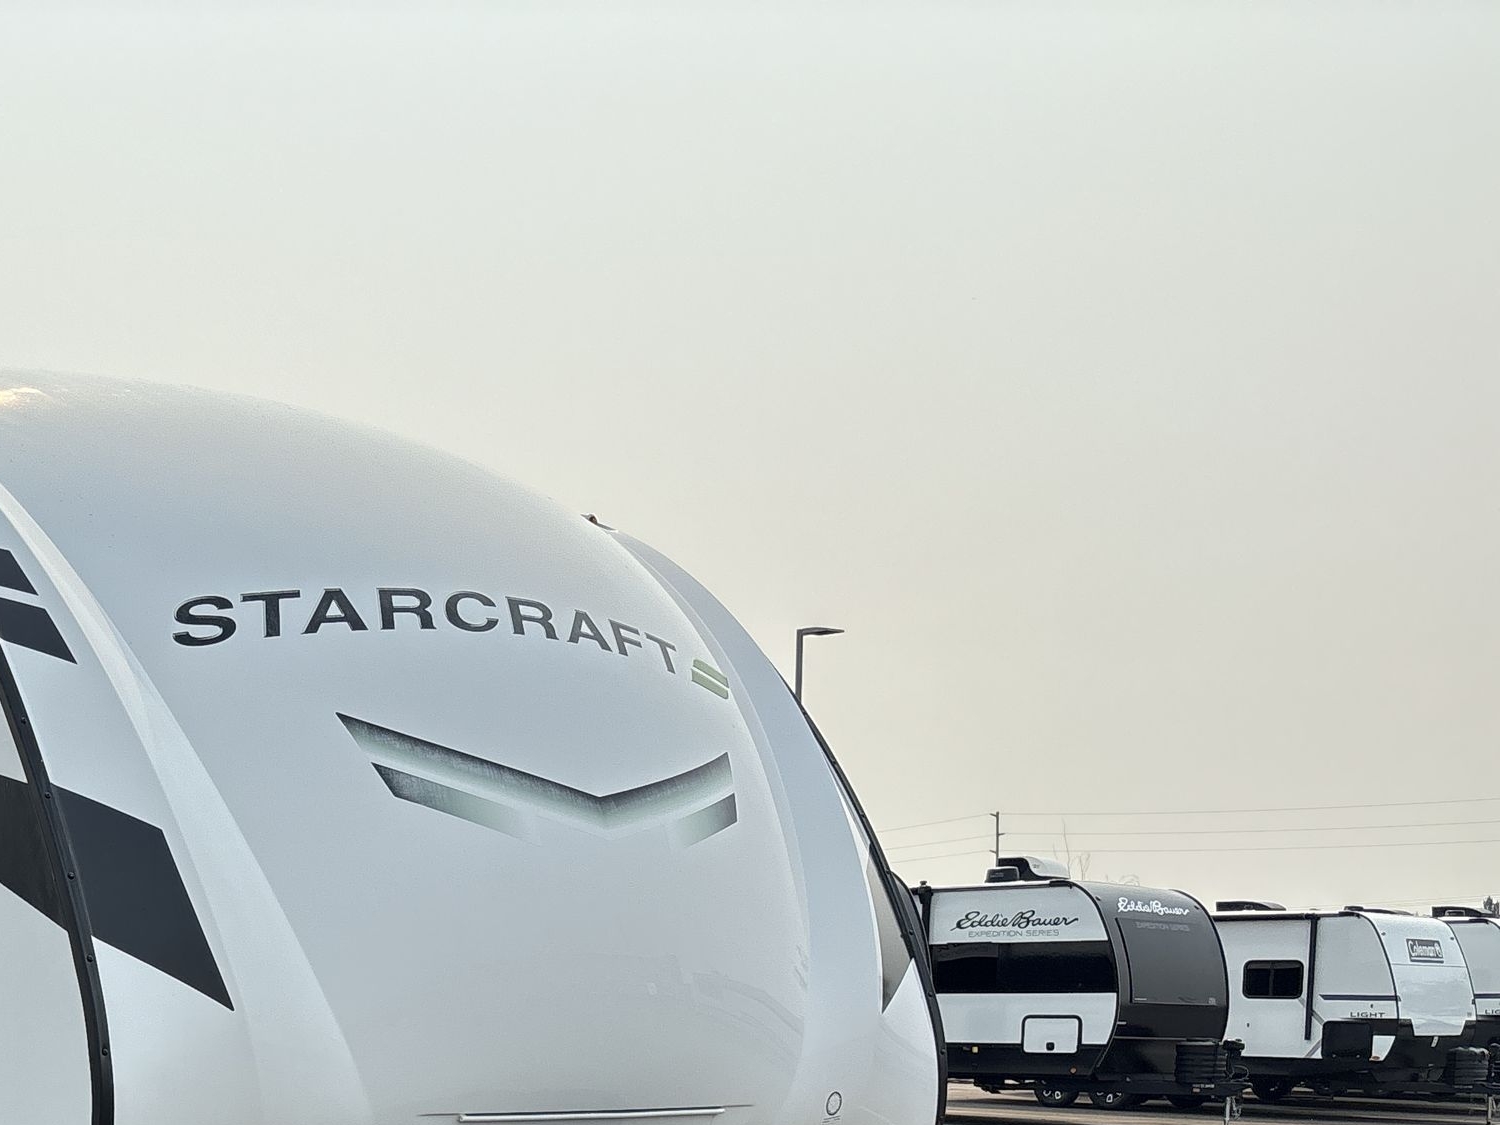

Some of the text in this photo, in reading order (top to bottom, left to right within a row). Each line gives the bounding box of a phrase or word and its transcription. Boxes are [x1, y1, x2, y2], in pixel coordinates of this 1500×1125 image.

[171, 587, 677, 675] STARCRAFT
[1117, 897, 1190, 916] Eddie Bauer
[950, 910, 1079, 931] Eddie Bauer
[968, 929, 1060, 938] EXPEDITION SERIES
